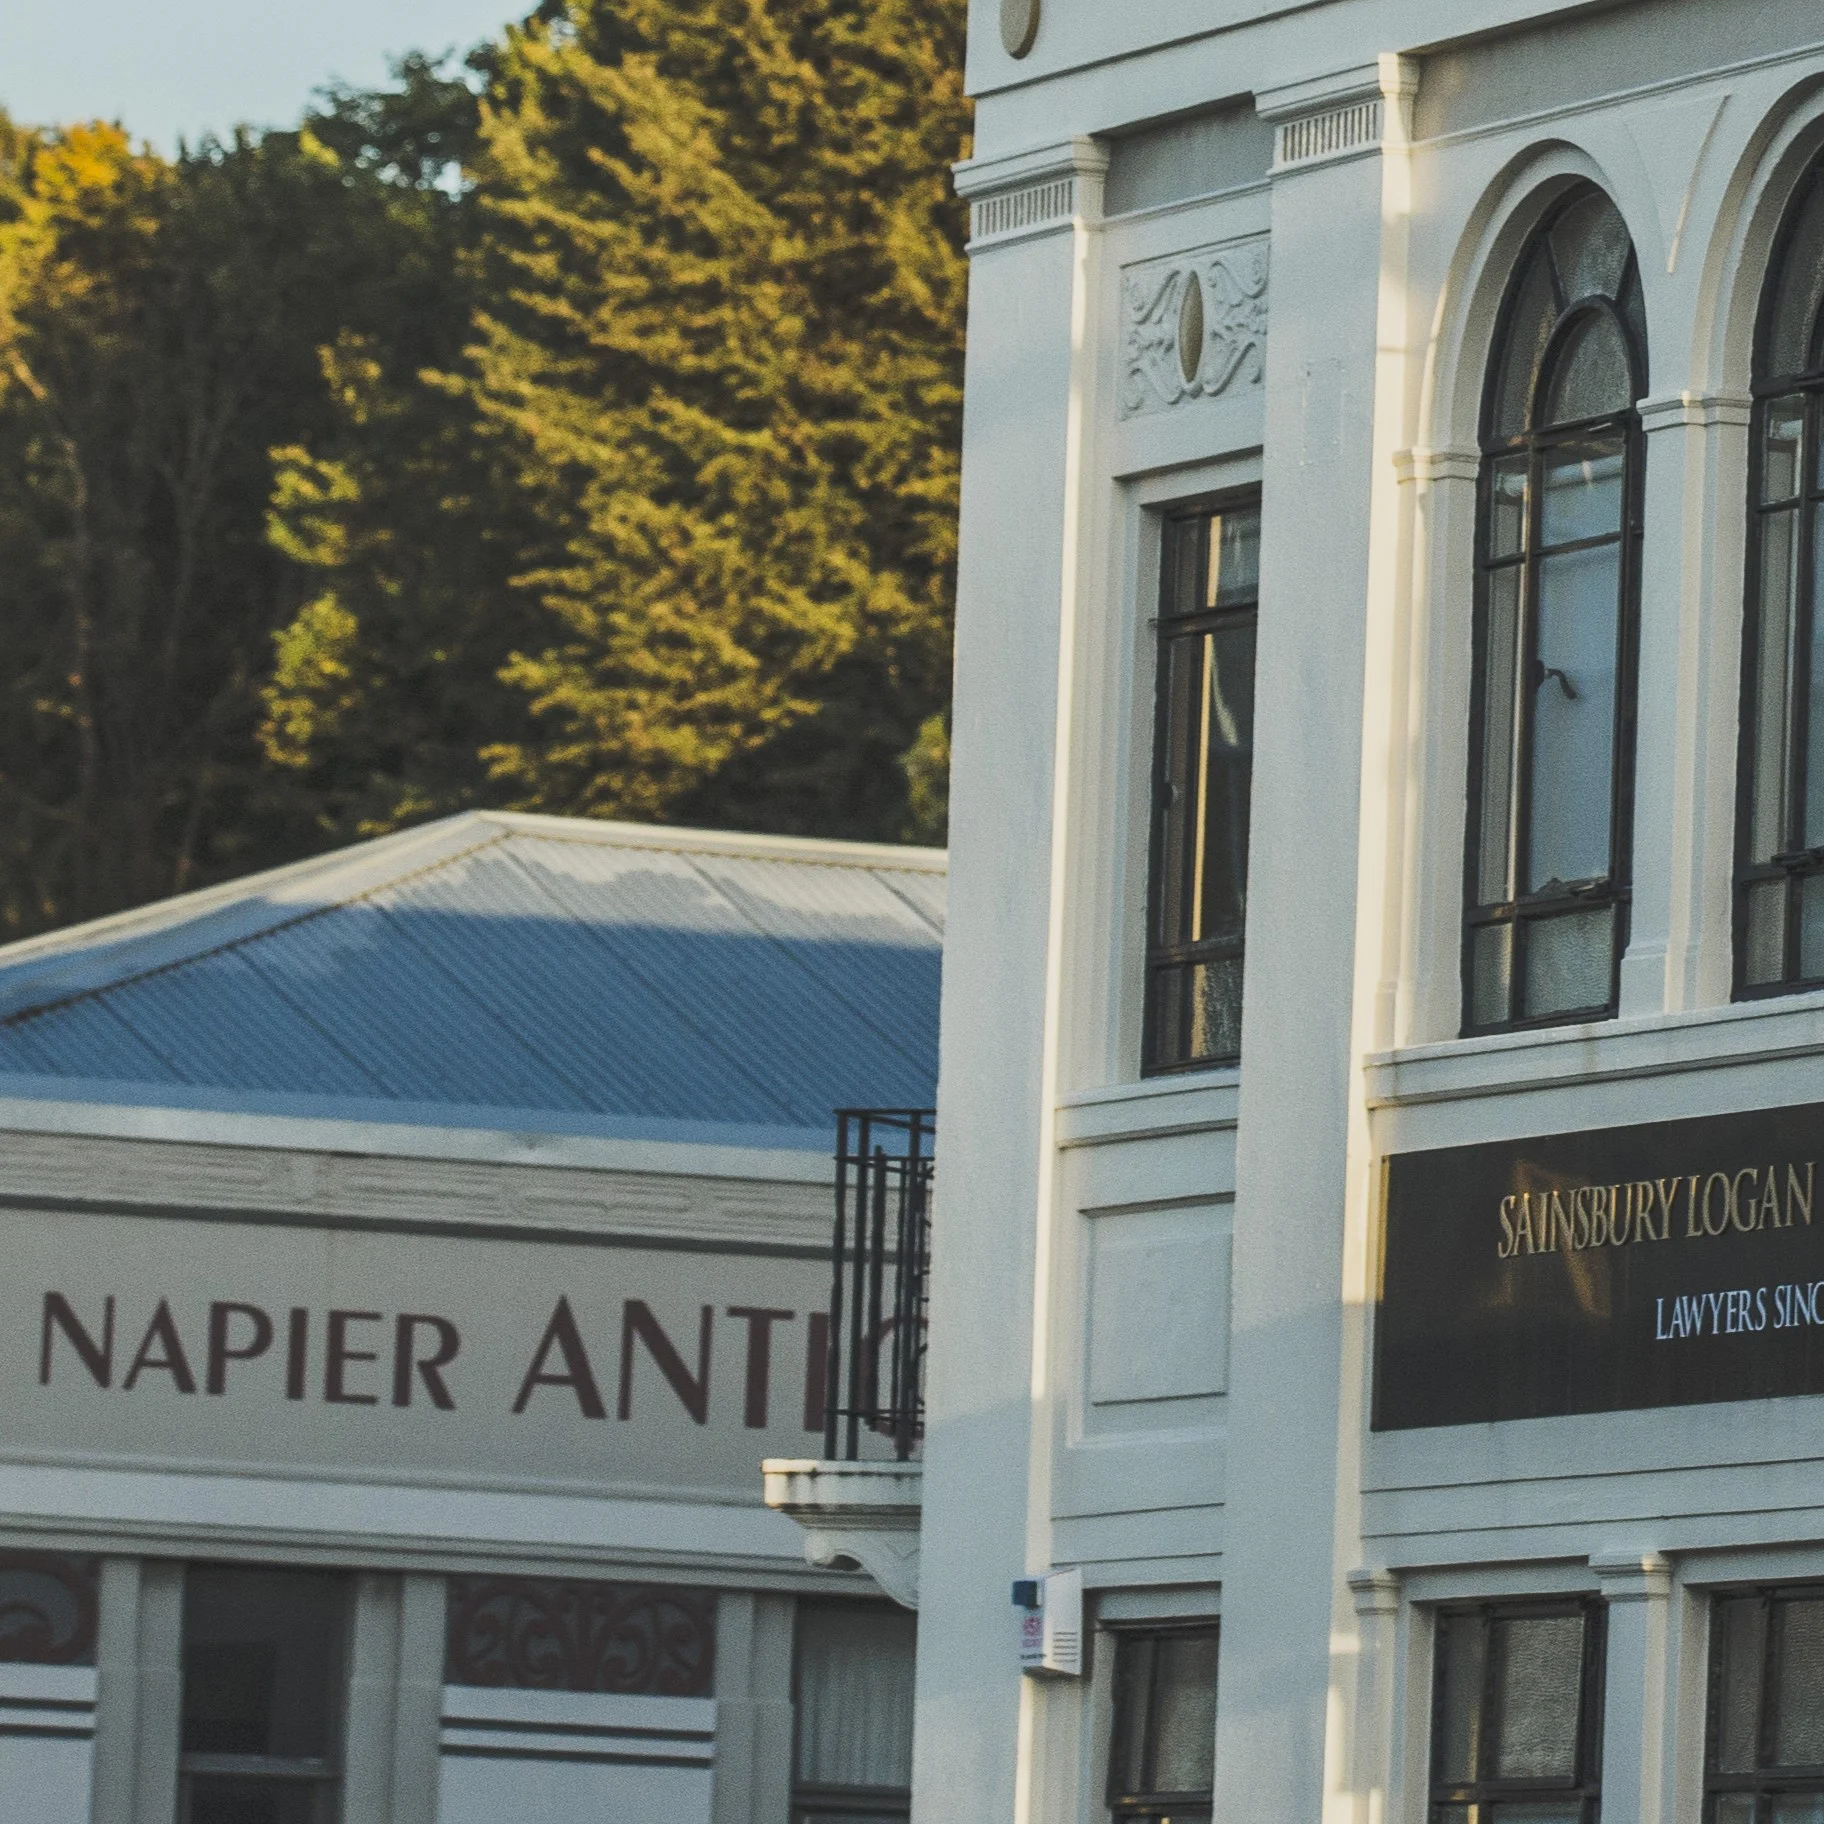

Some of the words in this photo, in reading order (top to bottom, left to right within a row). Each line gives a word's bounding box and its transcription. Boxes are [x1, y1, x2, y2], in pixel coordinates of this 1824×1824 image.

[1497, 1176, 1684, 1259] SAINSBURY
[1680, 1160, 1818, 1237] LOGAN
[38, 1290, 462, 1412] NAPIER
[1655, 1286, 1768, 1341] LAWYERS
